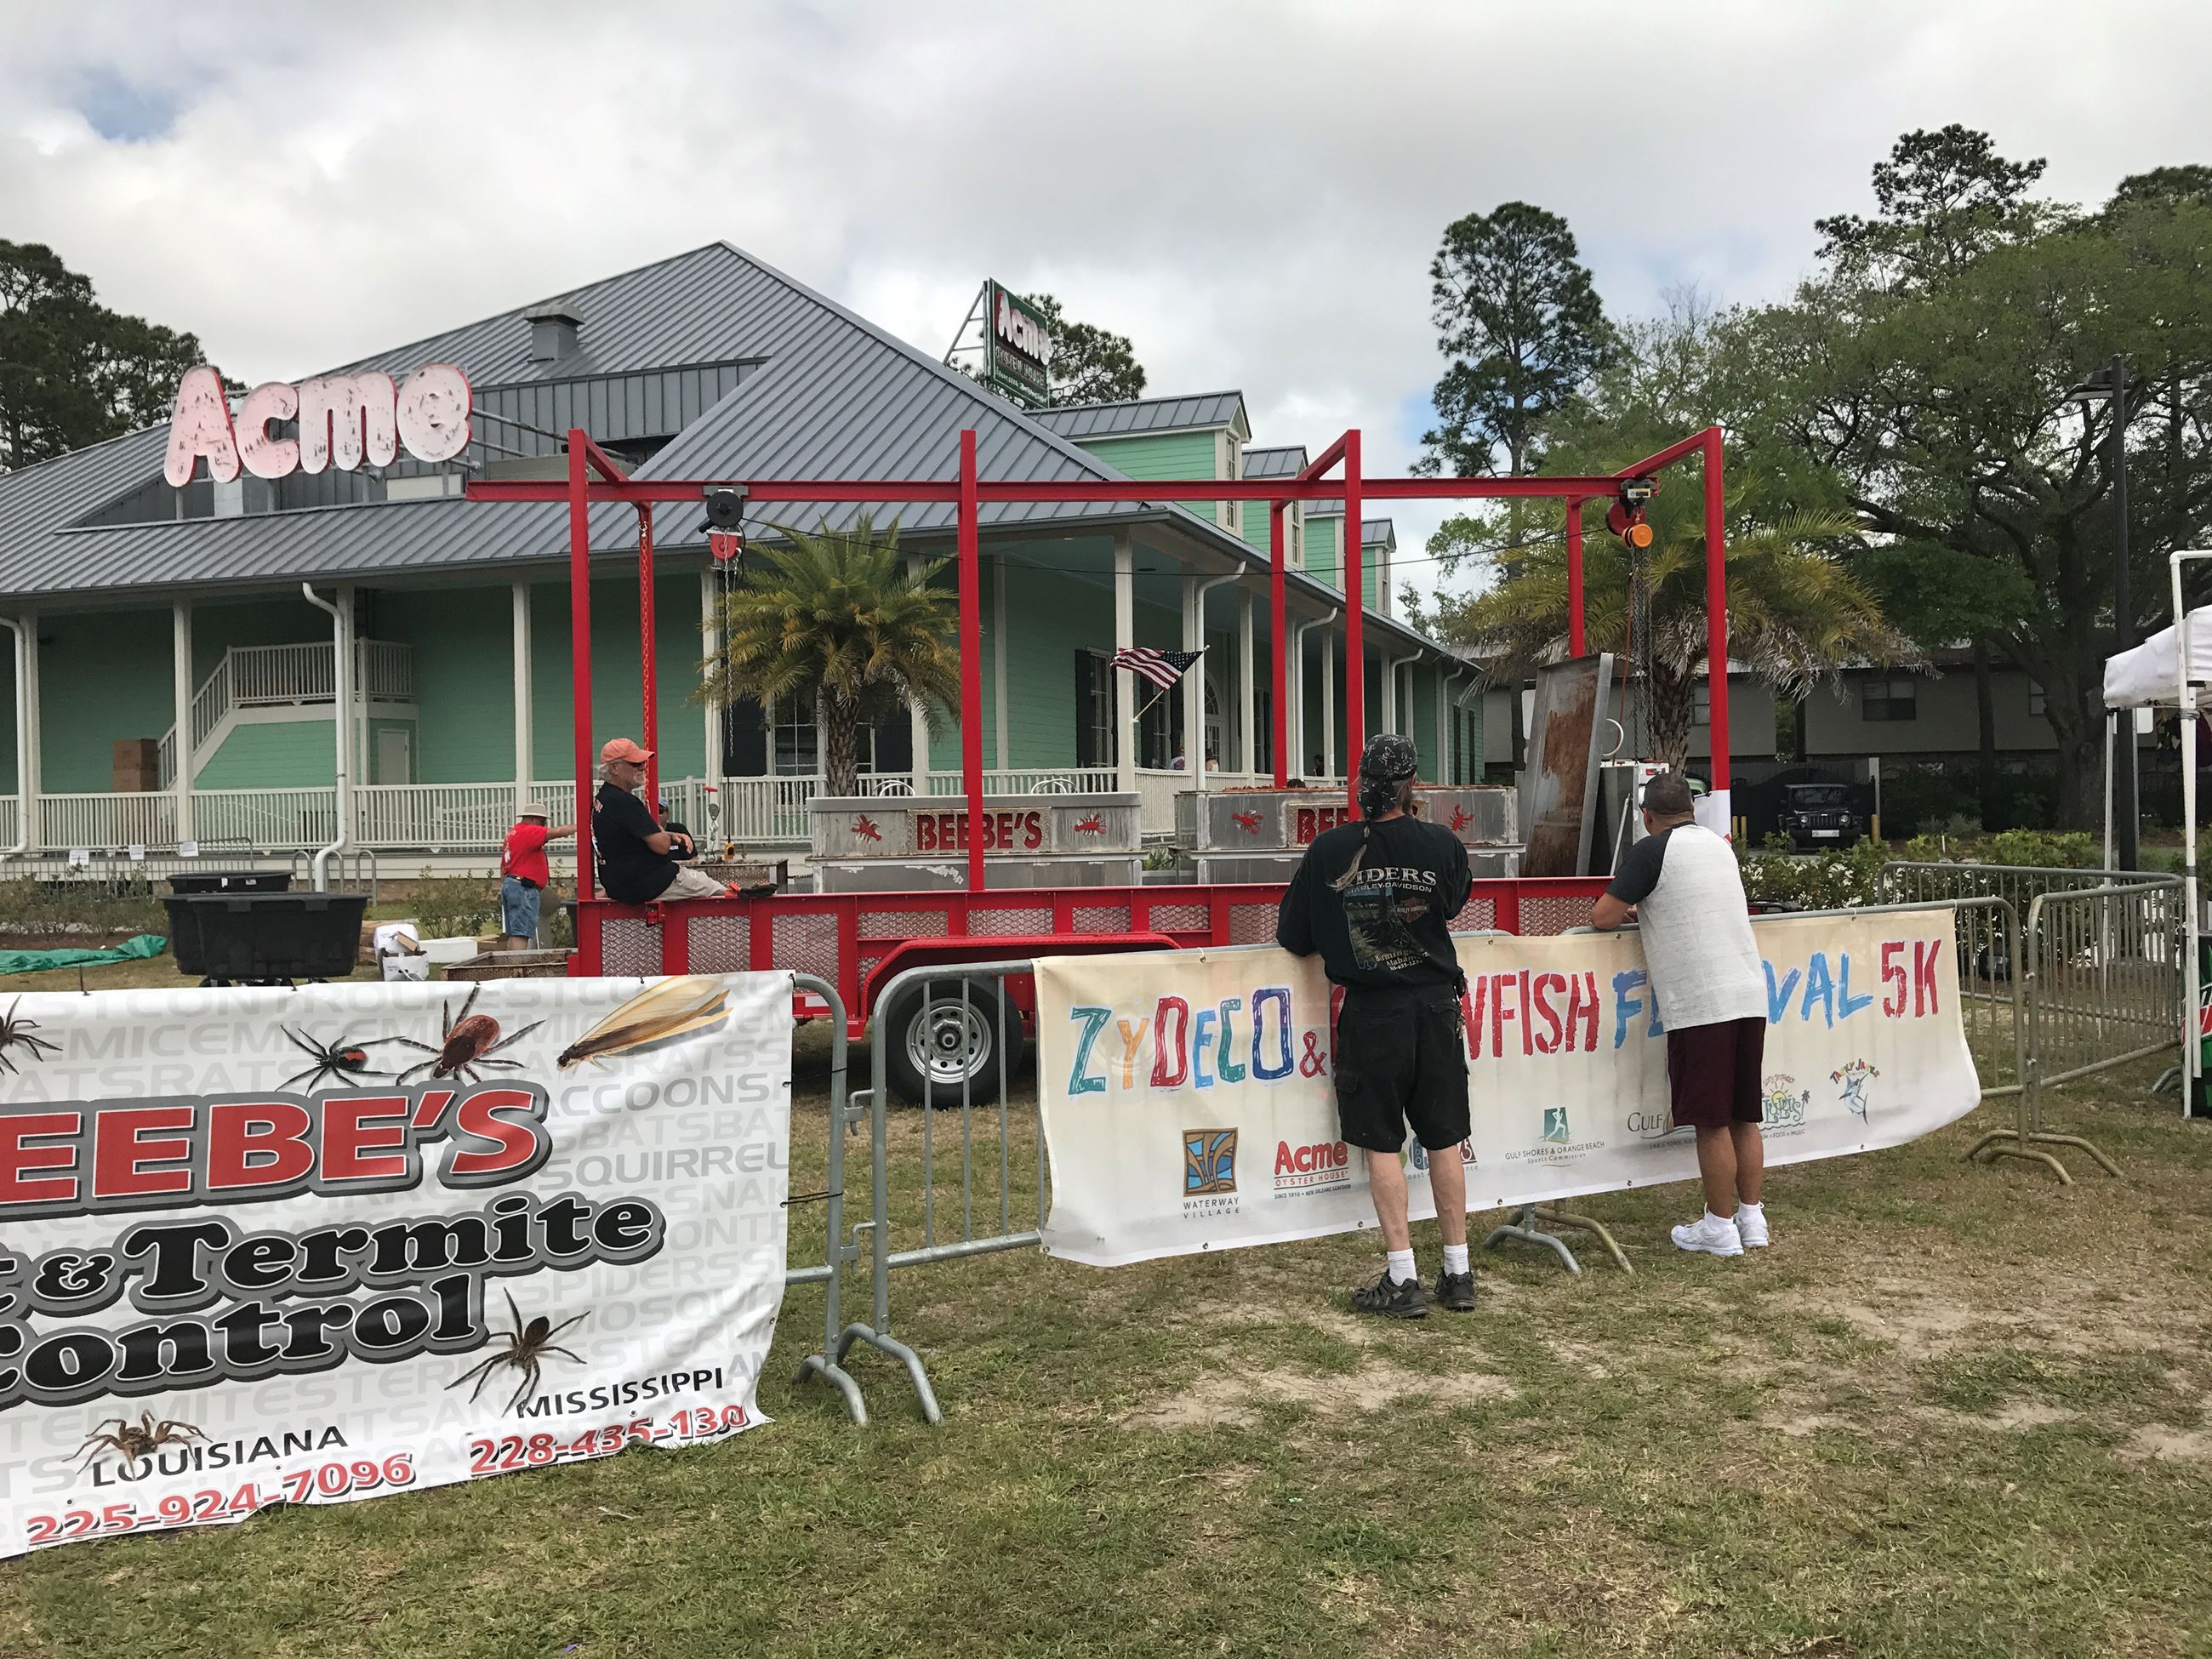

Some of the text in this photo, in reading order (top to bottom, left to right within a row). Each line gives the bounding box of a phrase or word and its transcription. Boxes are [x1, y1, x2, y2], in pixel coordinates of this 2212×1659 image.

[995, 290, 1054, 366] Acme
[164, 362, 472, 487] Acme
[917, 811, 1042, 850] BEEBE'S
[1336, 866, 1437, 887] IDERS
[1347, 881, 1432, 894] HARLEY-DAVIDSON
[1068, 988, 1294, 1096] ZYDECO
[1299, 1029, 1329, 1079] &
[1881, 939, 1942, 1018] 5K
[1274, 1140, 1348, 1175] Acme
[1505, 1151, 1521, 1160] GULF
[1523, 1147, 1548, 1158] SHORES
[1557, 1143, 1584, 1154] ORANGE
[1585, 1141, 1605, 1150] BEACH
[1275, 1172, 1346, 1187] OYSTER HOUSE
[1407, 1172, 1424, 1180] oast
[1183, 1196, 1240, 1210] WATERWAY
[1183, 1206, 1240, 1218] VILLAGE
[32, 1254, 115, 1300] &
[123, 1196, 653, 1298] Termite
[516, 1367, 723, 1420] MISSISSIPPI
[92, 1425, 348, 1487] LOUISIANA
[26, 1451, 416, 1545] 225-924-7096
